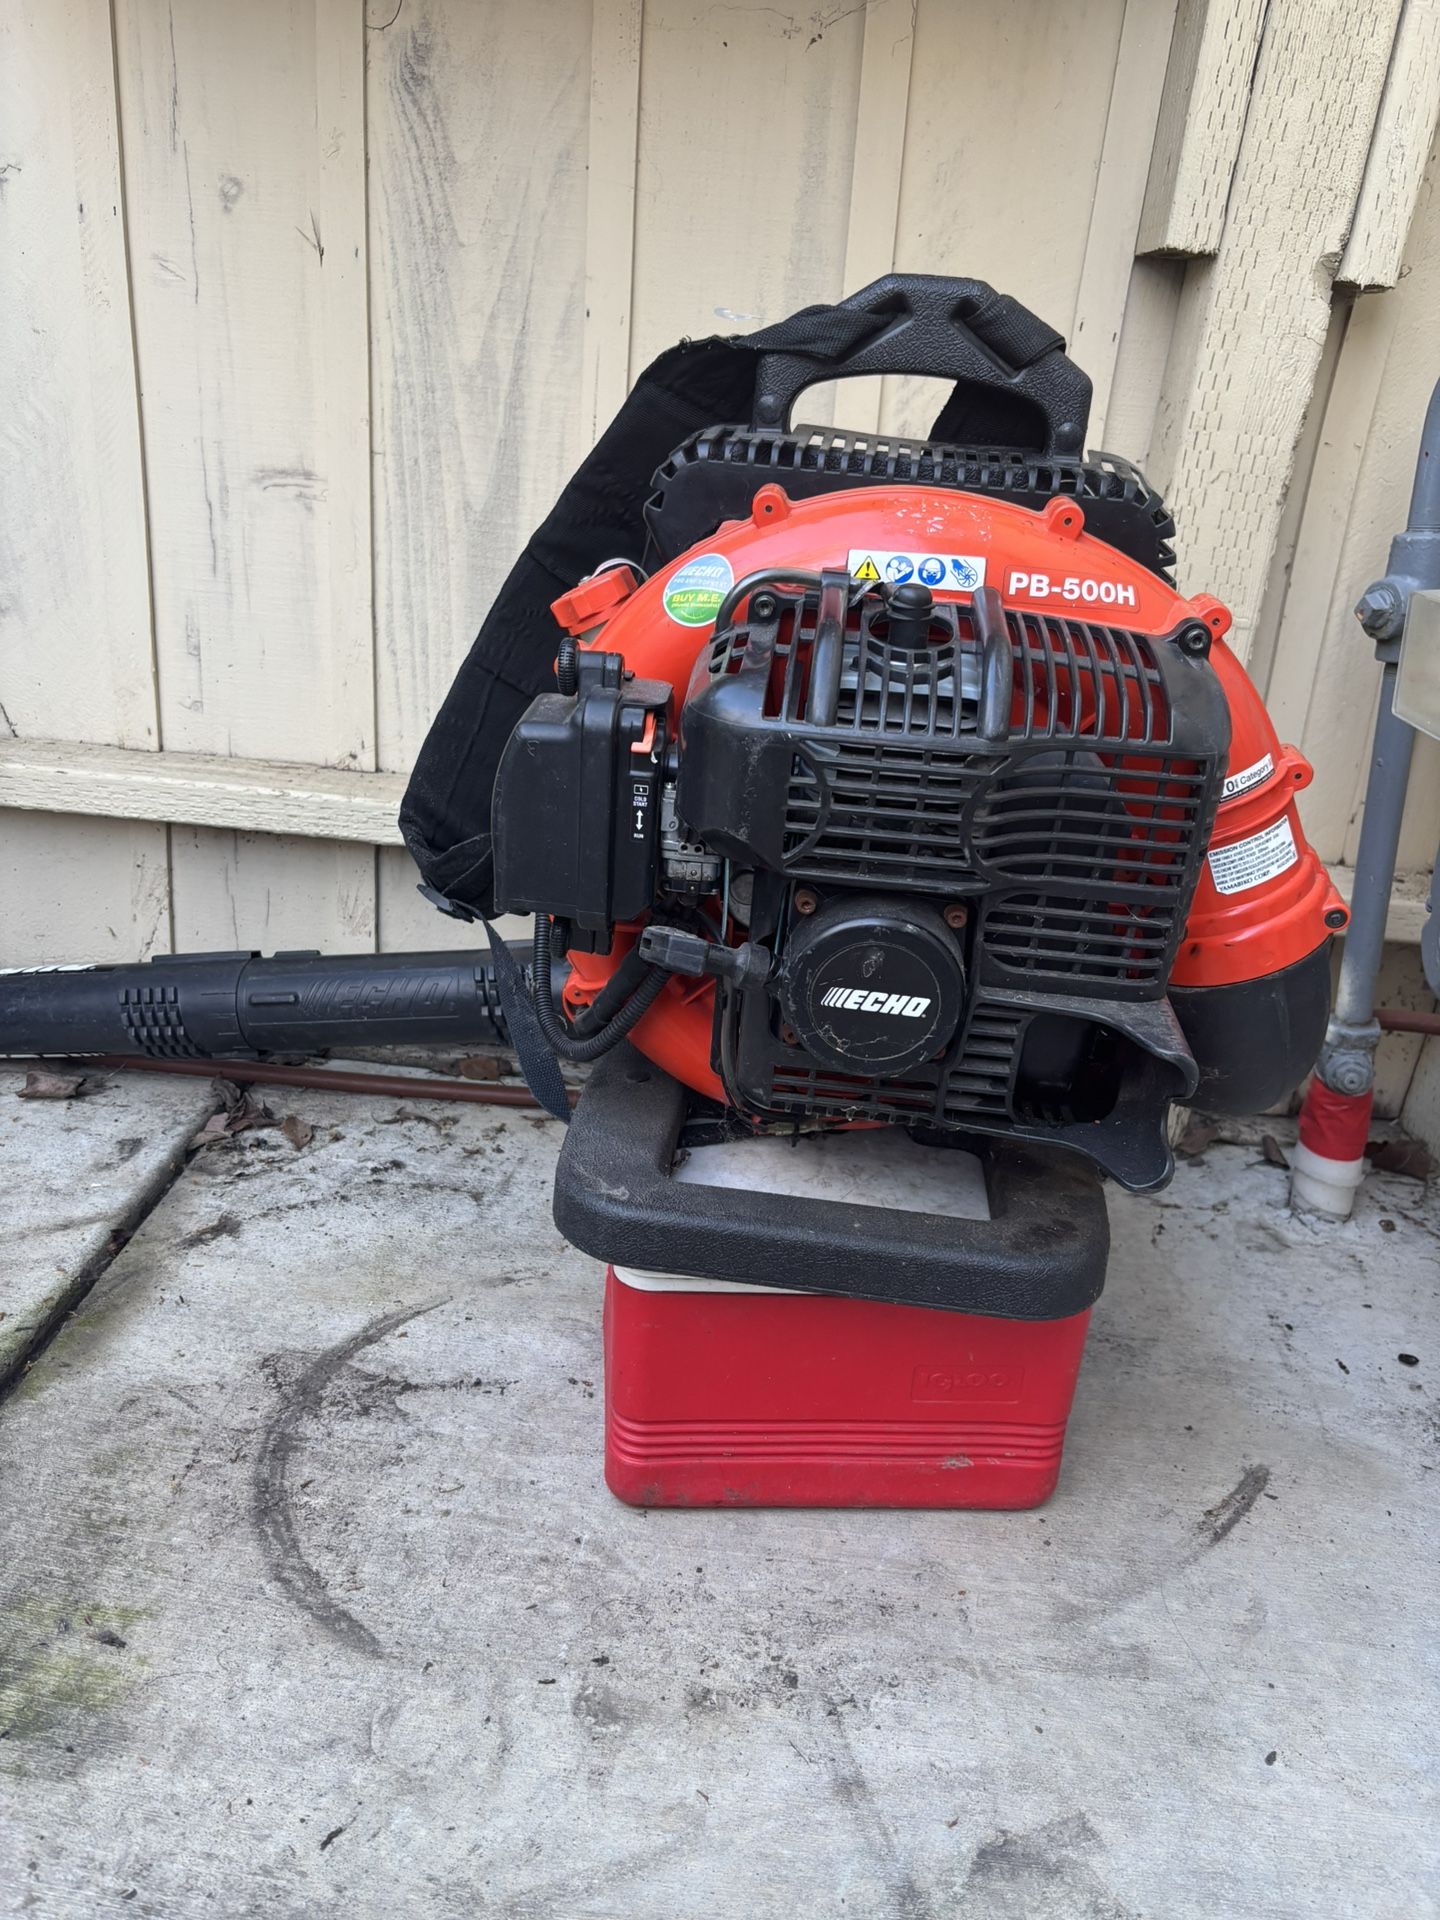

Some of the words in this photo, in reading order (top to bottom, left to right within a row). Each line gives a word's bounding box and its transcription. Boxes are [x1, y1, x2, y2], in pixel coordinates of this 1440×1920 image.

[672, 593, 696, 603] BUY
[697, 593, 721, 603] M.E.
[1008, 571, 1136, 606] PB-500H
[1240, 764, 1270, 786] Category
[1209, 845, 1238, 858] EMISSION
[1238, 835, 1264, 849] CONTROL
[332, 975, 454, 1012] ECHO
[838, 987, 932, 1018] ECHO
